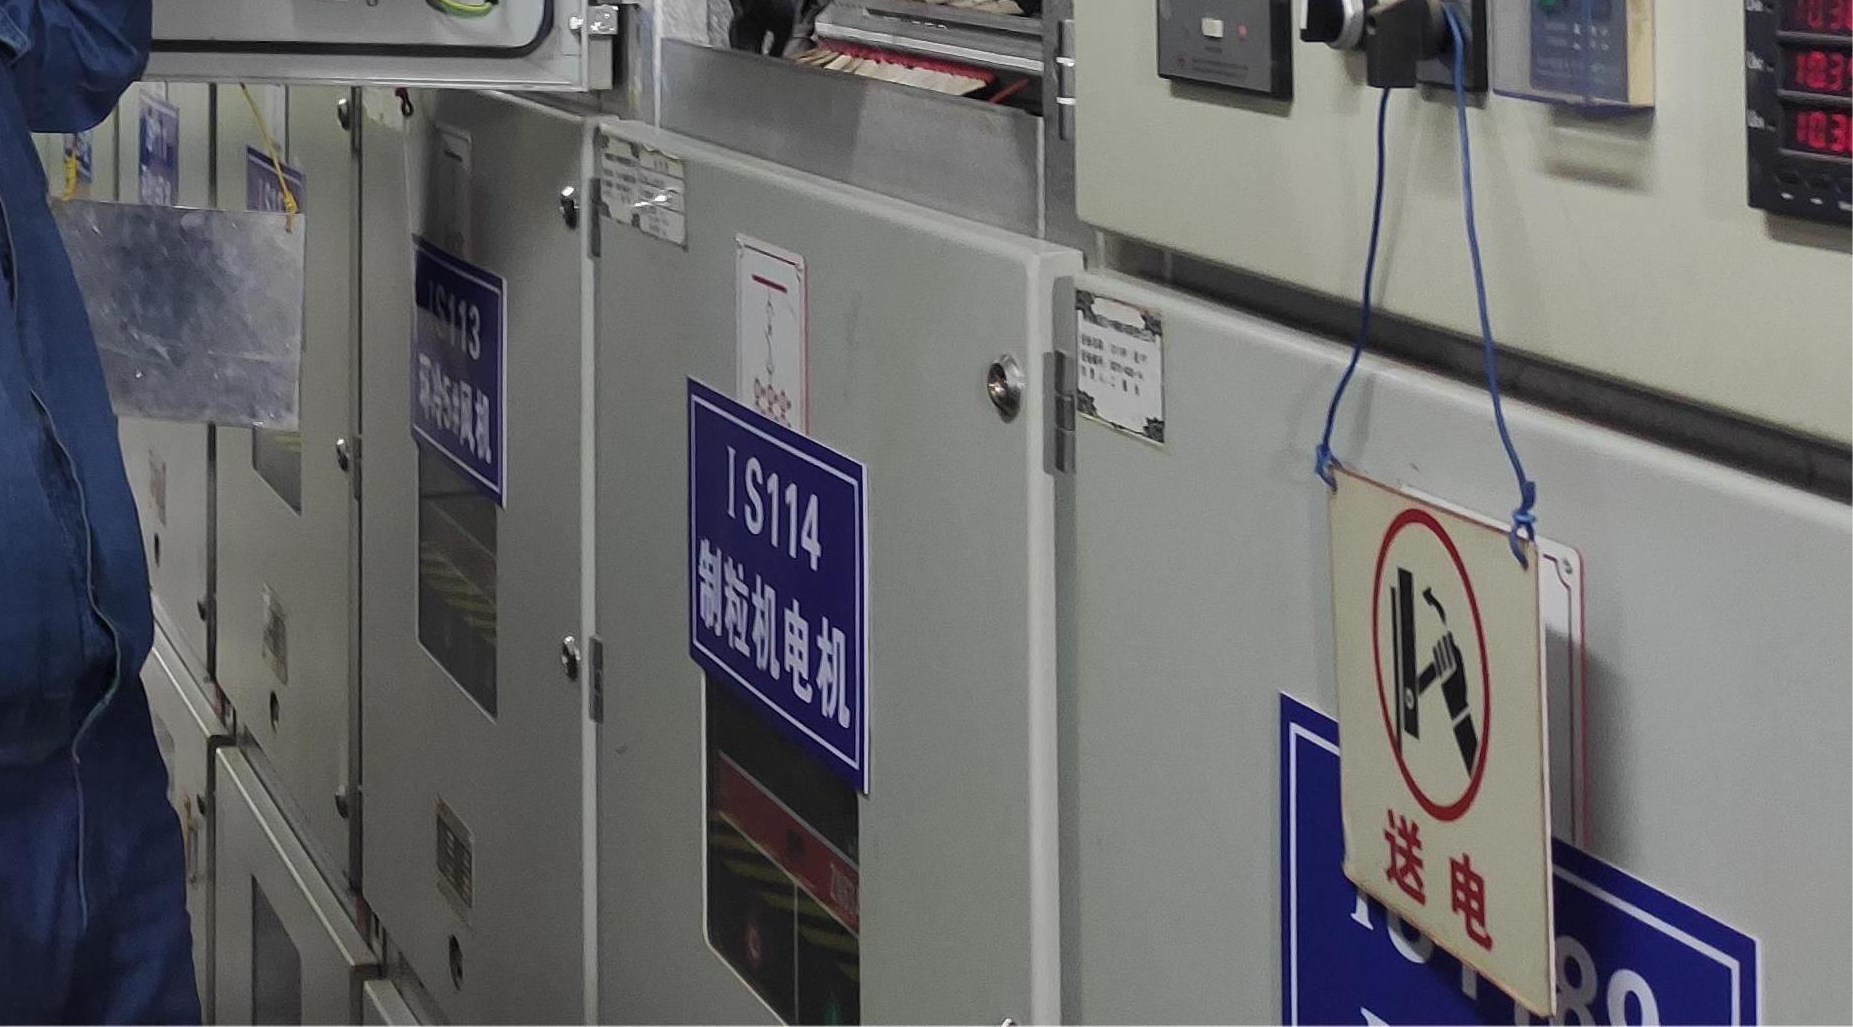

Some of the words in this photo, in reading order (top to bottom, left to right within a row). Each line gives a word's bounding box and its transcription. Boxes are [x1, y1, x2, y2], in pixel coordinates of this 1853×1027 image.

[428, 279, 481, 360] IS113
[697, 538, 850, 729] 制粒机电机
[1383, 808, 1493, 952] 送电
